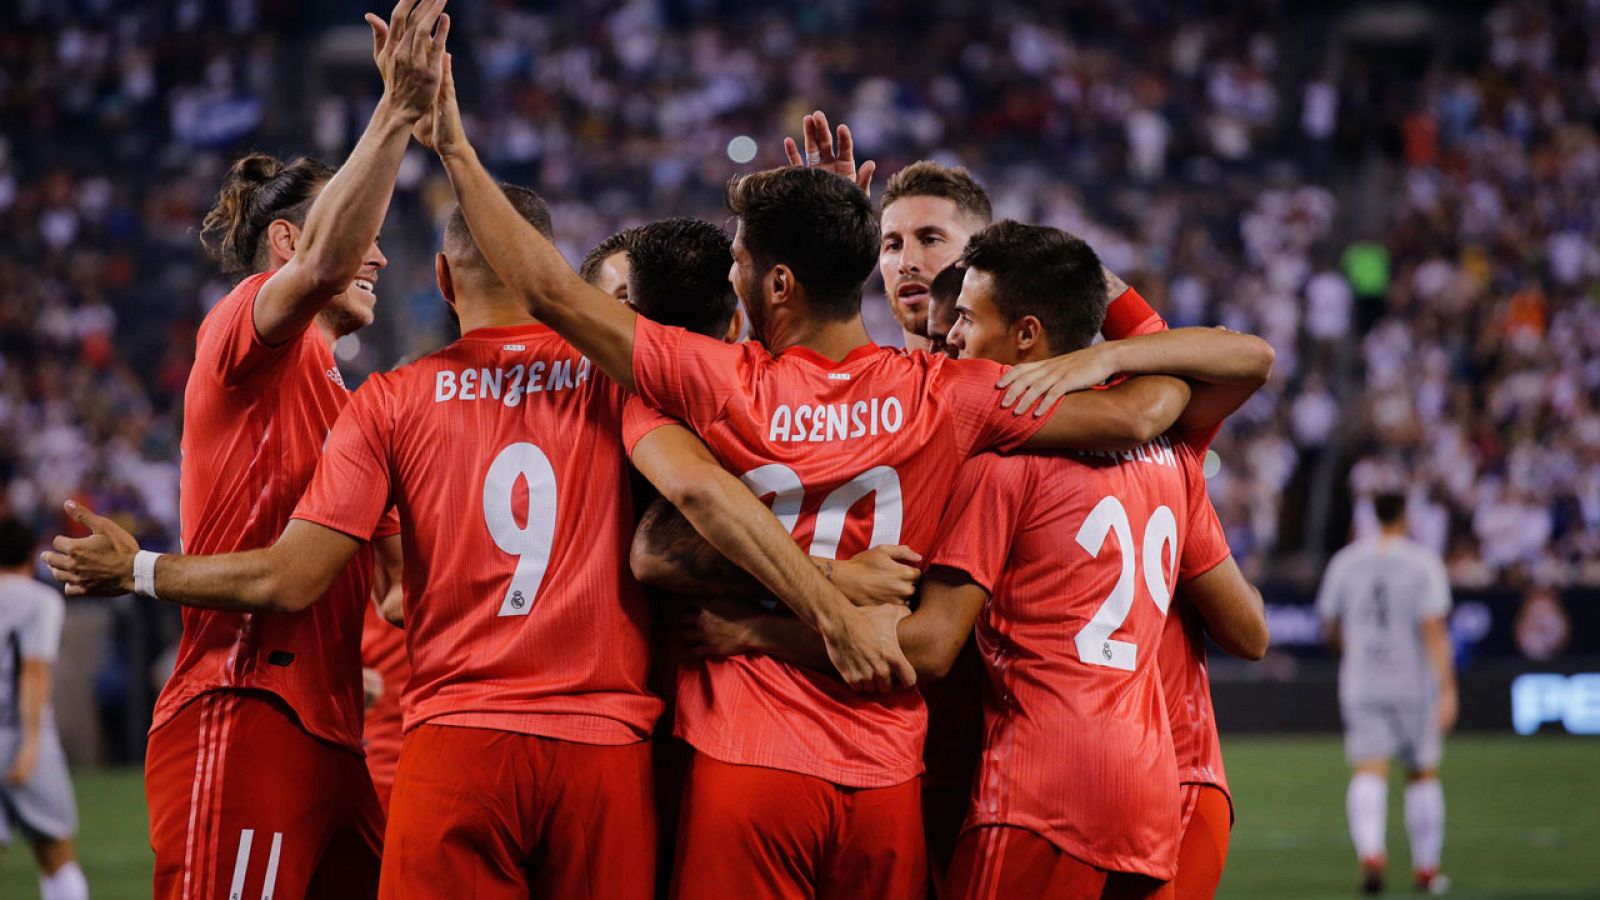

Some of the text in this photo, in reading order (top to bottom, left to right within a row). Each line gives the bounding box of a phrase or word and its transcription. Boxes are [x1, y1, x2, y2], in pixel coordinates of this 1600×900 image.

[435, 355, 591, 408] BENZEMA
[769, 396, 904, 442] ASENSIO
[483, 441, 557, 617] 9
[1074, 495, 1178, 671] 20
